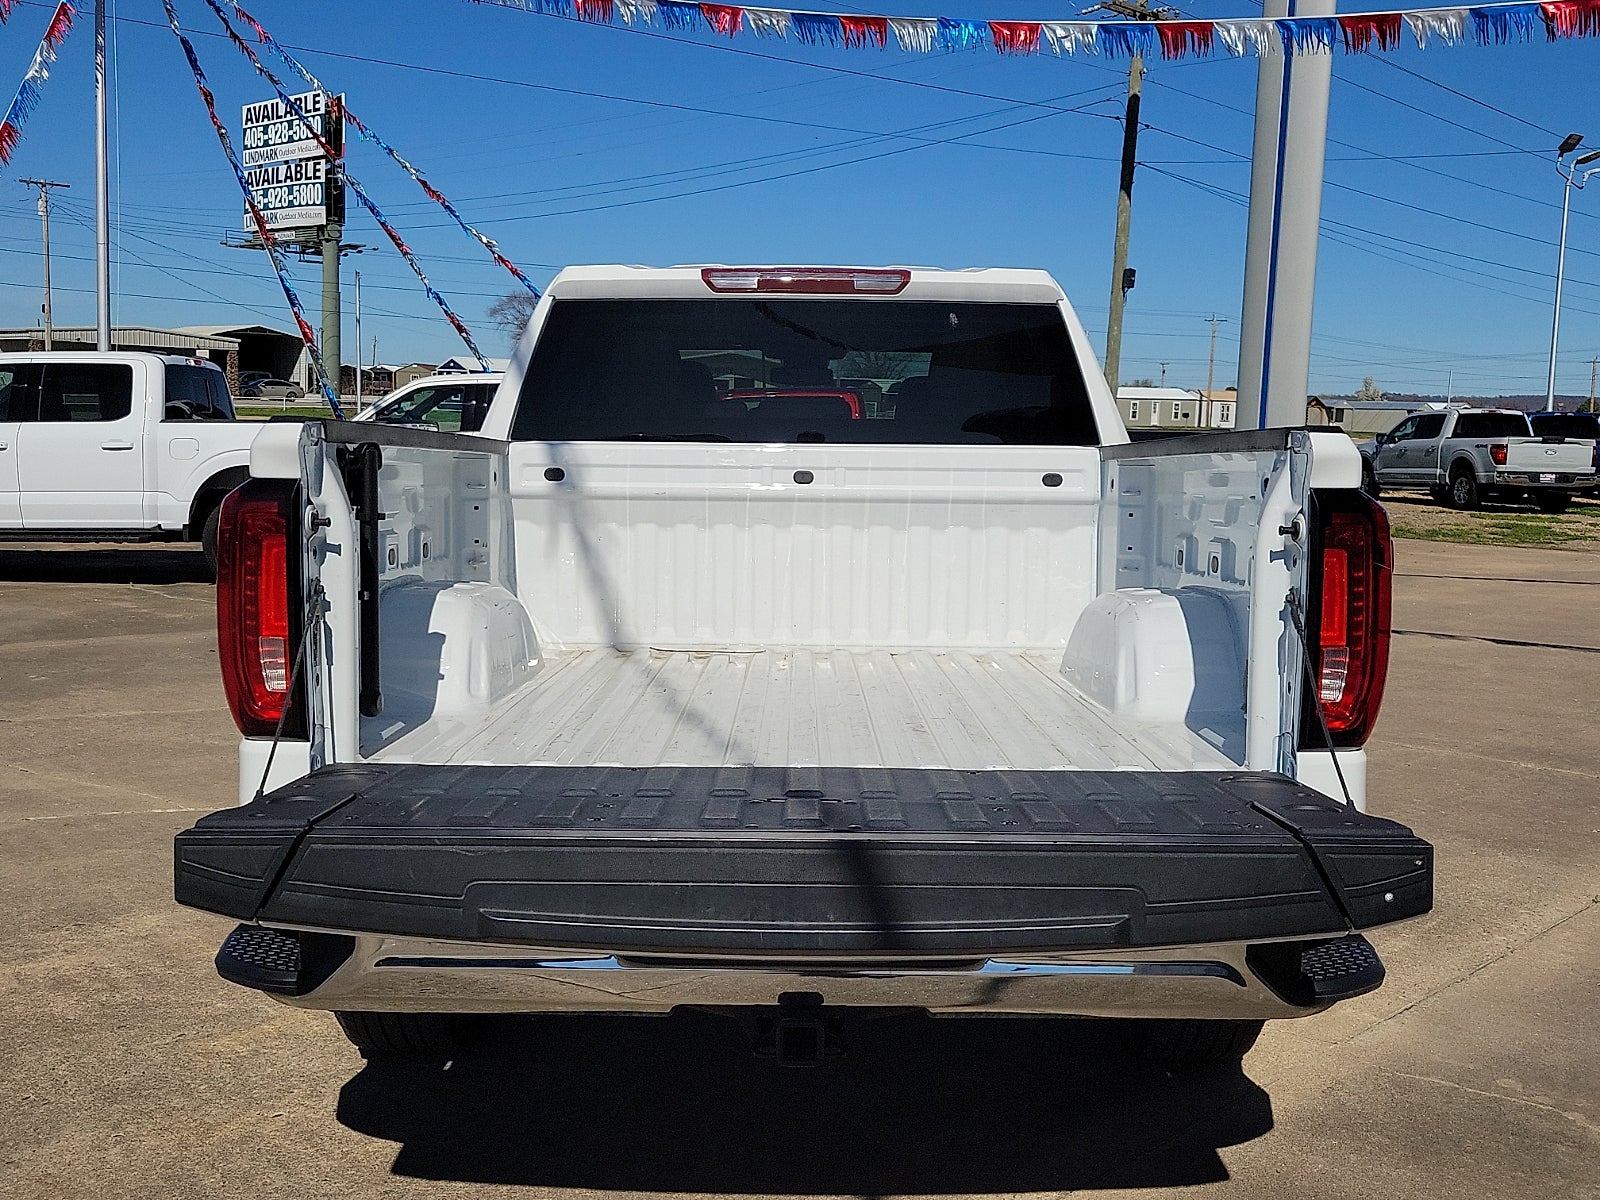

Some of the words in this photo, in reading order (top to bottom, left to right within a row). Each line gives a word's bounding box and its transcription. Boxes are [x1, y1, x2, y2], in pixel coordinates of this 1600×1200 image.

[244, 92, 321, 126] AVAILABLE
[244, 148, 279, 165] LINDMARK
[279, 147, 297, 157] Outdoor
[246, 161, 322, 189] AVAILABLE
[245, 211, 280, 229] LINARK
[279, 212, 297, 221] Outdoor
